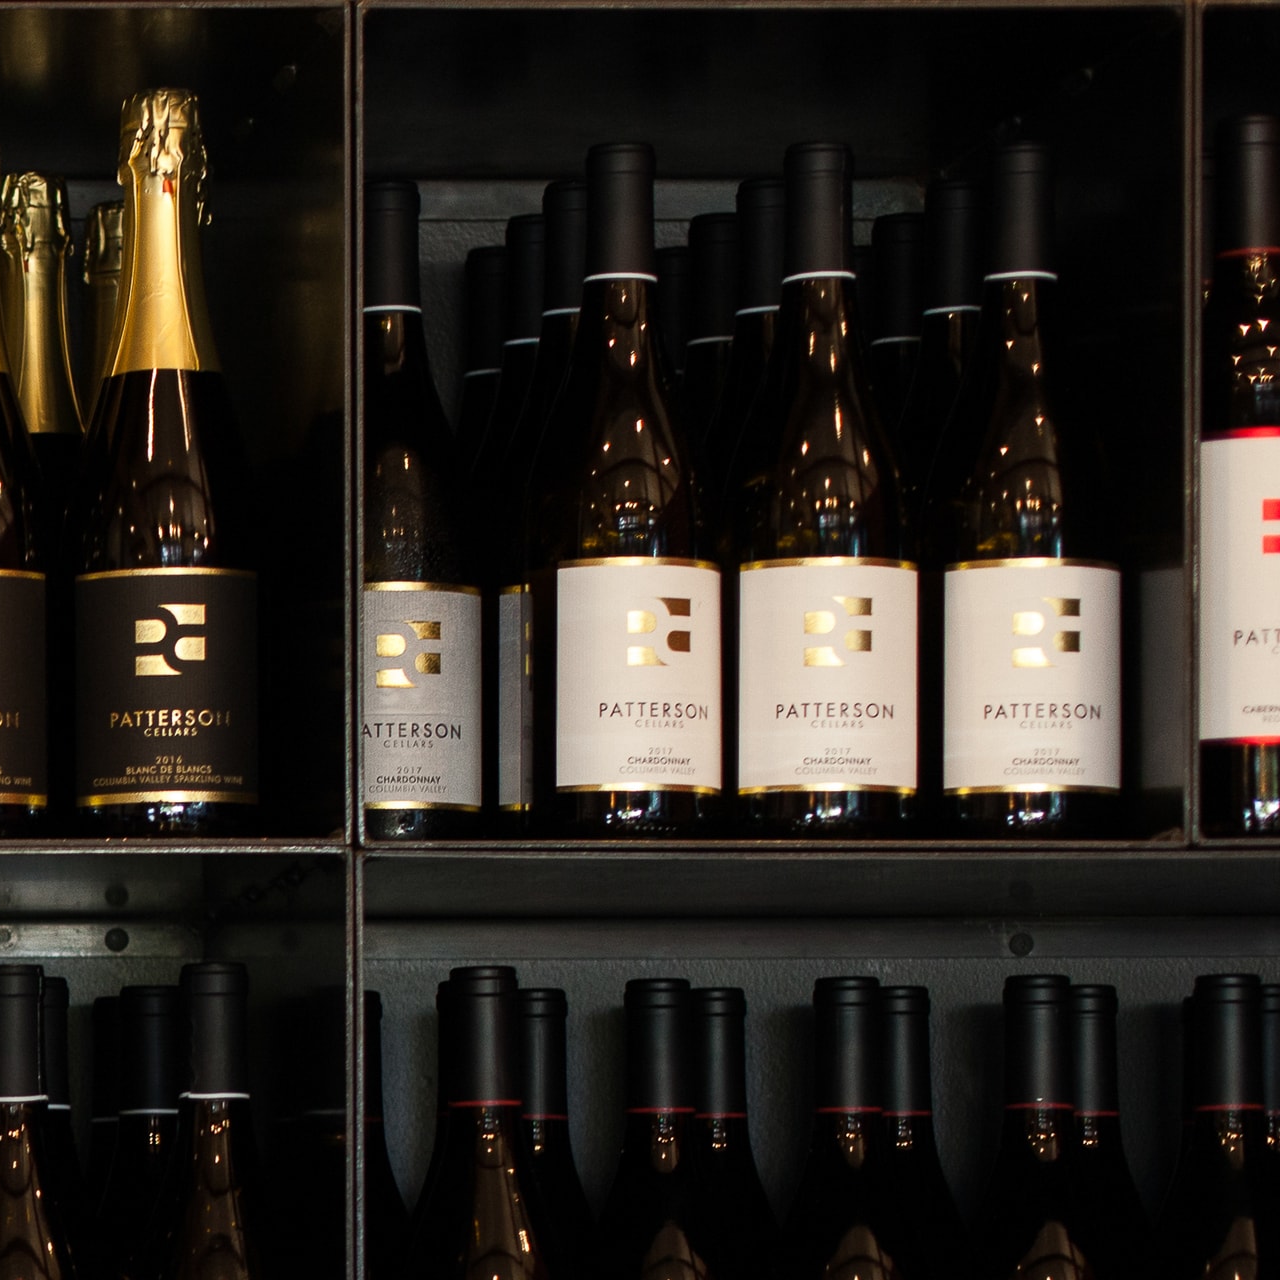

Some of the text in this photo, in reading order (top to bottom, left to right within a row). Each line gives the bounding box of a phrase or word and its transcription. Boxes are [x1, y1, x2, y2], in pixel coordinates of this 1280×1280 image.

[599, 702, 708, 719] PATTERSON
[775, 703, 894, 720] PATTERSON
[983, 703, 1102, 720] PATTERSON
[110, 710, 231, 728] PATTERSON
[635, 719, 684, 728] CELLARS
[144, 727, 198, 737] CELLARS
[363, 723, 461, 740] ATTERSON
[384, 740, 433, 749] CELLARS
[627, 756, 690, 765] CHARDONNAY
[803, 757, 871, 766] CHARDONNAY
[1012, 758, 1080, 766] CHARDONNAY
[376, 776, 441, 784] CHARDONNAY
